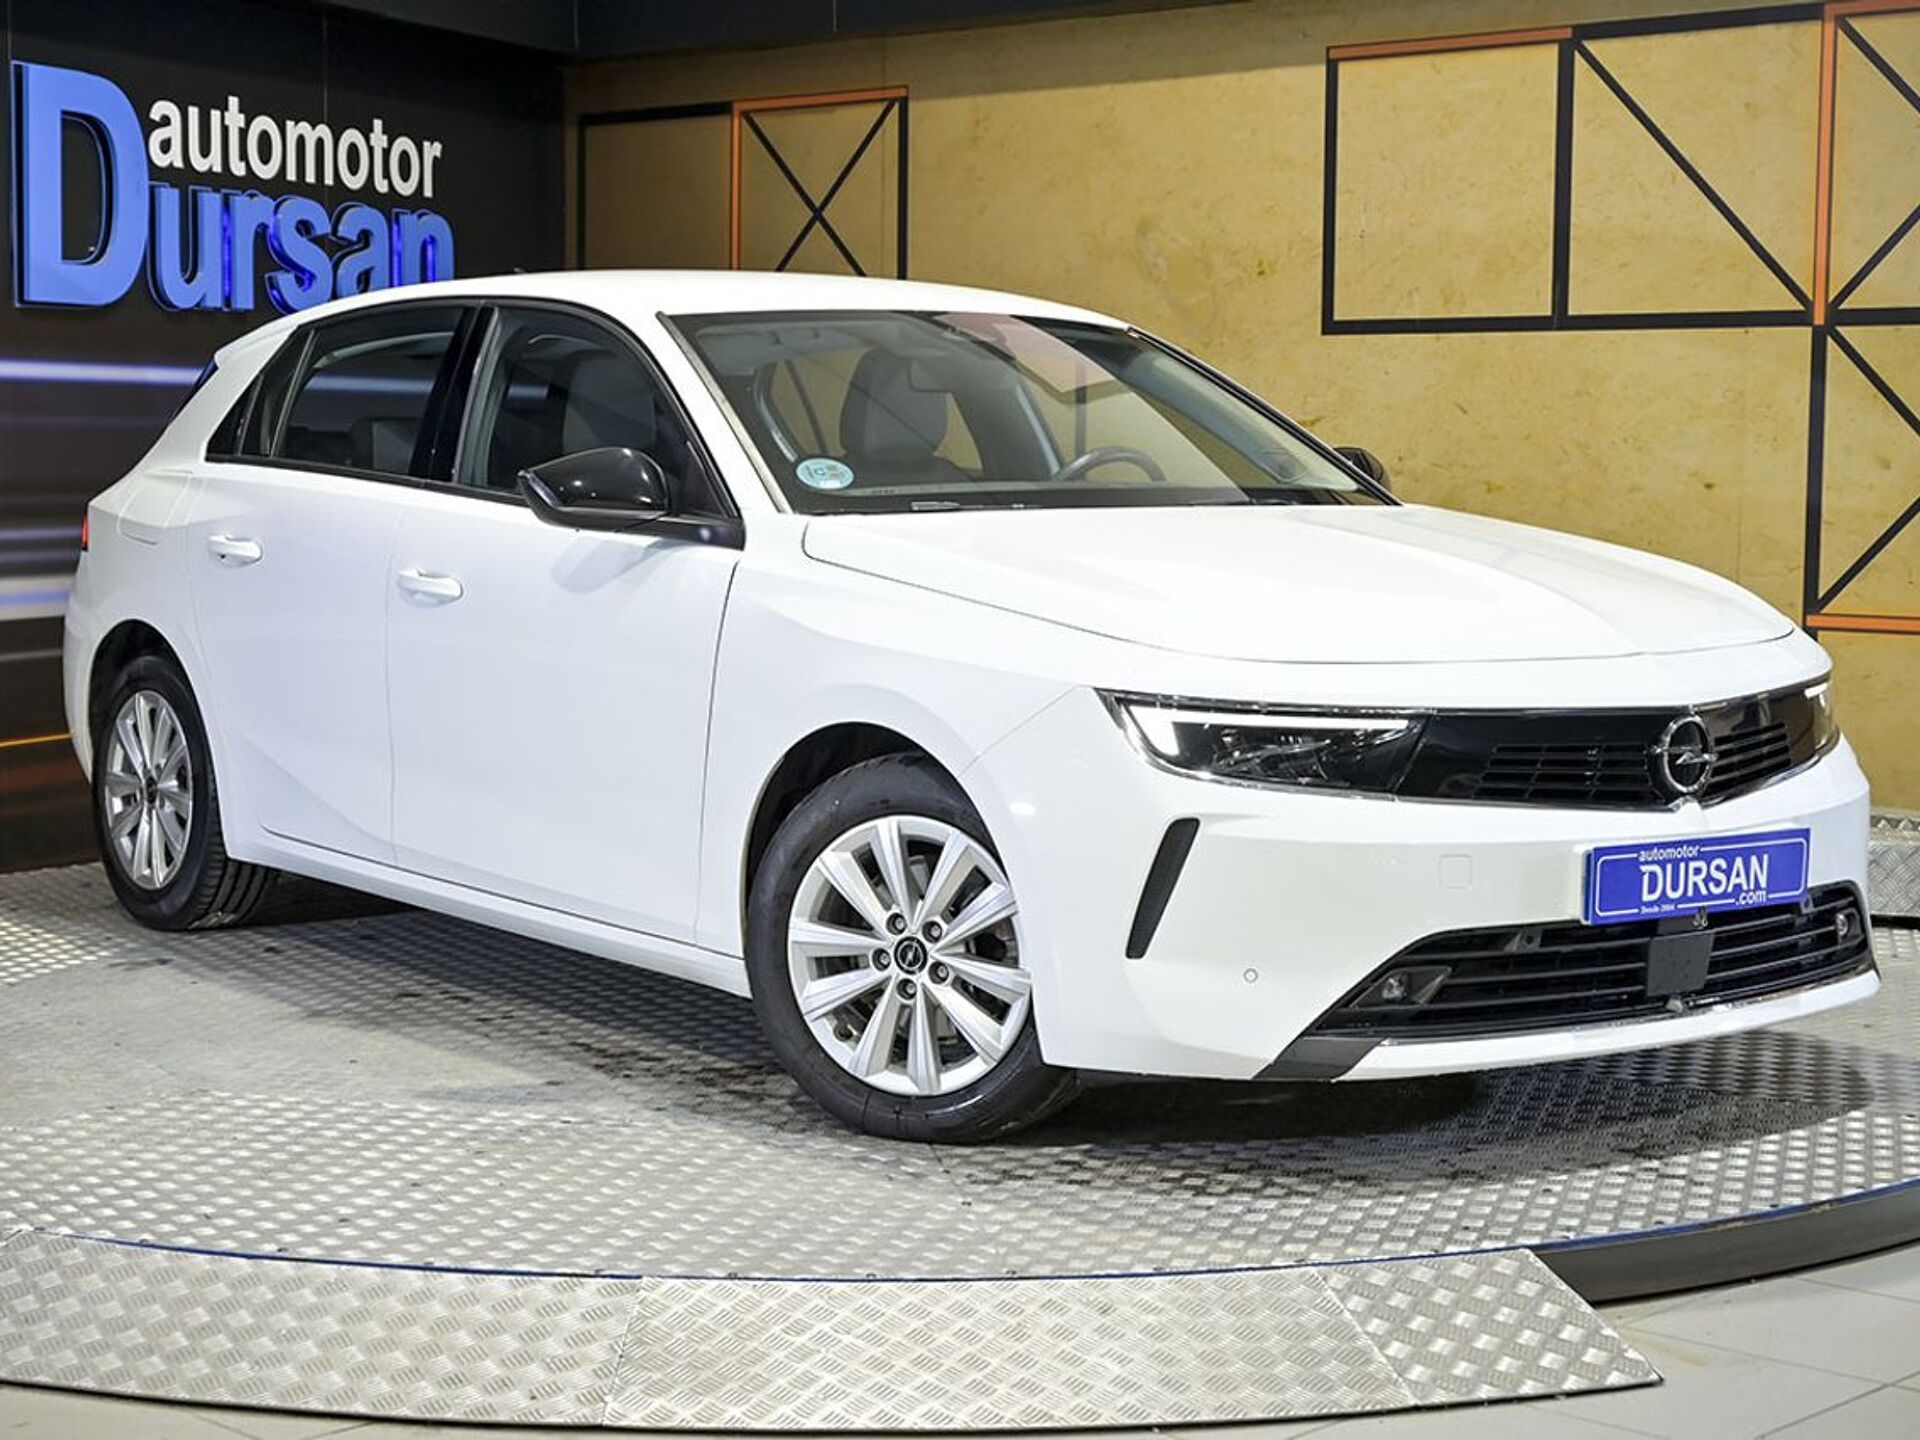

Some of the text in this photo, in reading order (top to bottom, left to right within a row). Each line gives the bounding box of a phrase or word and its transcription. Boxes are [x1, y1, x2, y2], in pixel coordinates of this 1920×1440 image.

[147, 95, 443, 199] automotor
[11, 60, 455, 316] Dursan
[1637, 844, 1701, 862] automotor
[1639, 854, 1769, 902] DURSAN
[1735, 888, 1767, 906] .com
